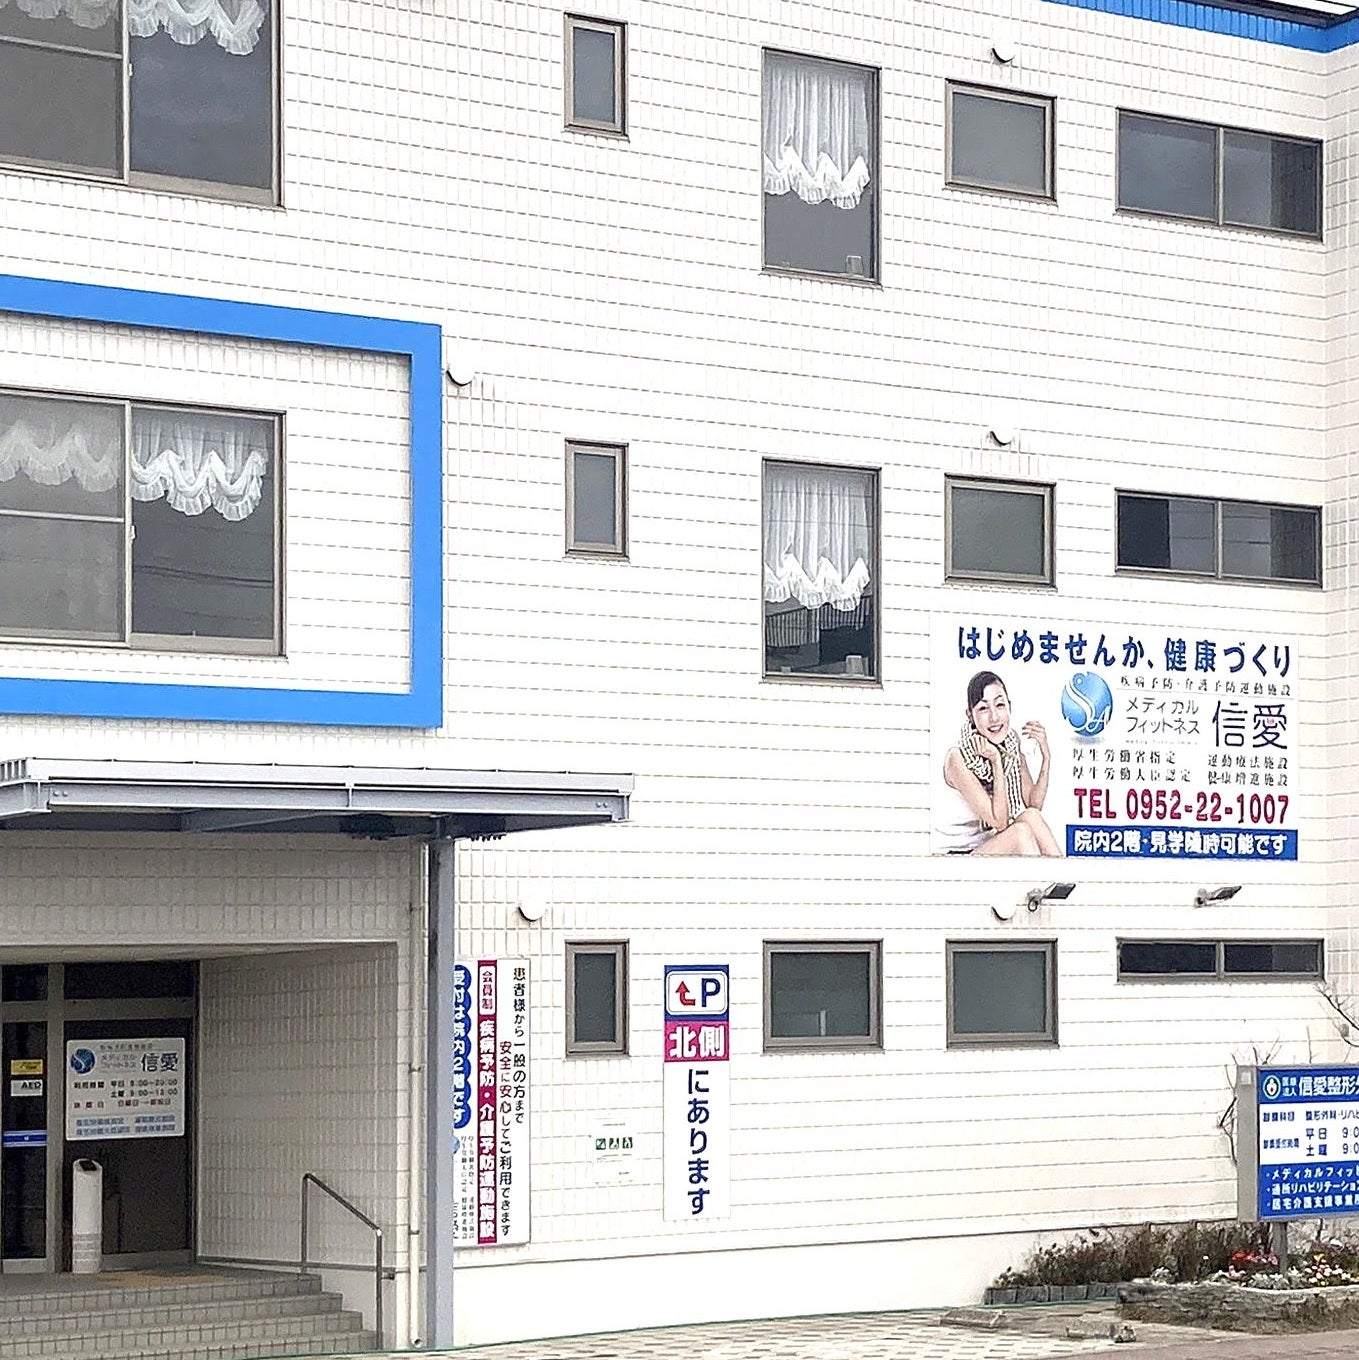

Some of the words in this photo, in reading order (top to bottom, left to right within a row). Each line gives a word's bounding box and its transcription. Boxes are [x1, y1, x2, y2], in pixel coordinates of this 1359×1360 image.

[958, 626, 1291, 678] はじめませんか、健康づくり
[1126, 697, 1200, 716] メディカル
[1126, 716, 1201, 735] フィットネス
[1212, 700, 1289, 750] 信愛
[1074, 788, 1118, 819] TEL
[1126, 788, 1290, 824] 0952-22-1007
[702, 978, 722, 1008] P
[669, 1024, 726, 1059] 北側
[140, 1053, 179, 1073] 信愛
[22, 1081, 42, 1090] AED
[687, 1068, 710, 1215] にあります
[1305, 1127, 1327, 1140] 平日
